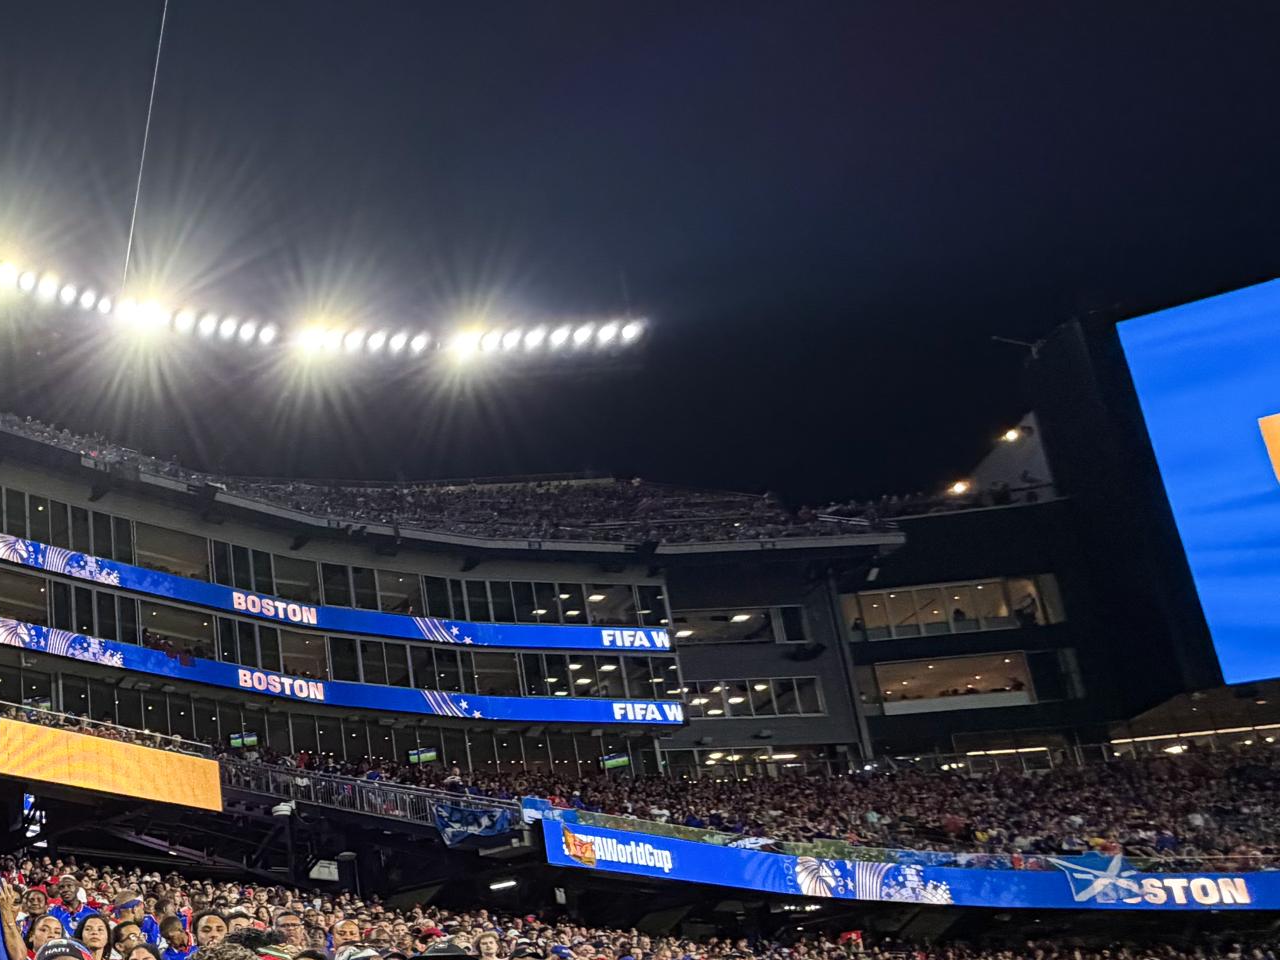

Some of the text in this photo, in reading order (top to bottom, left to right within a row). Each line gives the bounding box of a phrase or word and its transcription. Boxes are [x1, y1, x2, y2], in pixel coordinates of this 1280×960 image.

[232, 591, 317, 624] BOSTON
[601, 630, 671, 648] FIFA W
[238, 669, 325, 700] BOSTON
[612, 703, 684, 722] FIFA W
[562, 833, 673, 873] AWorldCup
